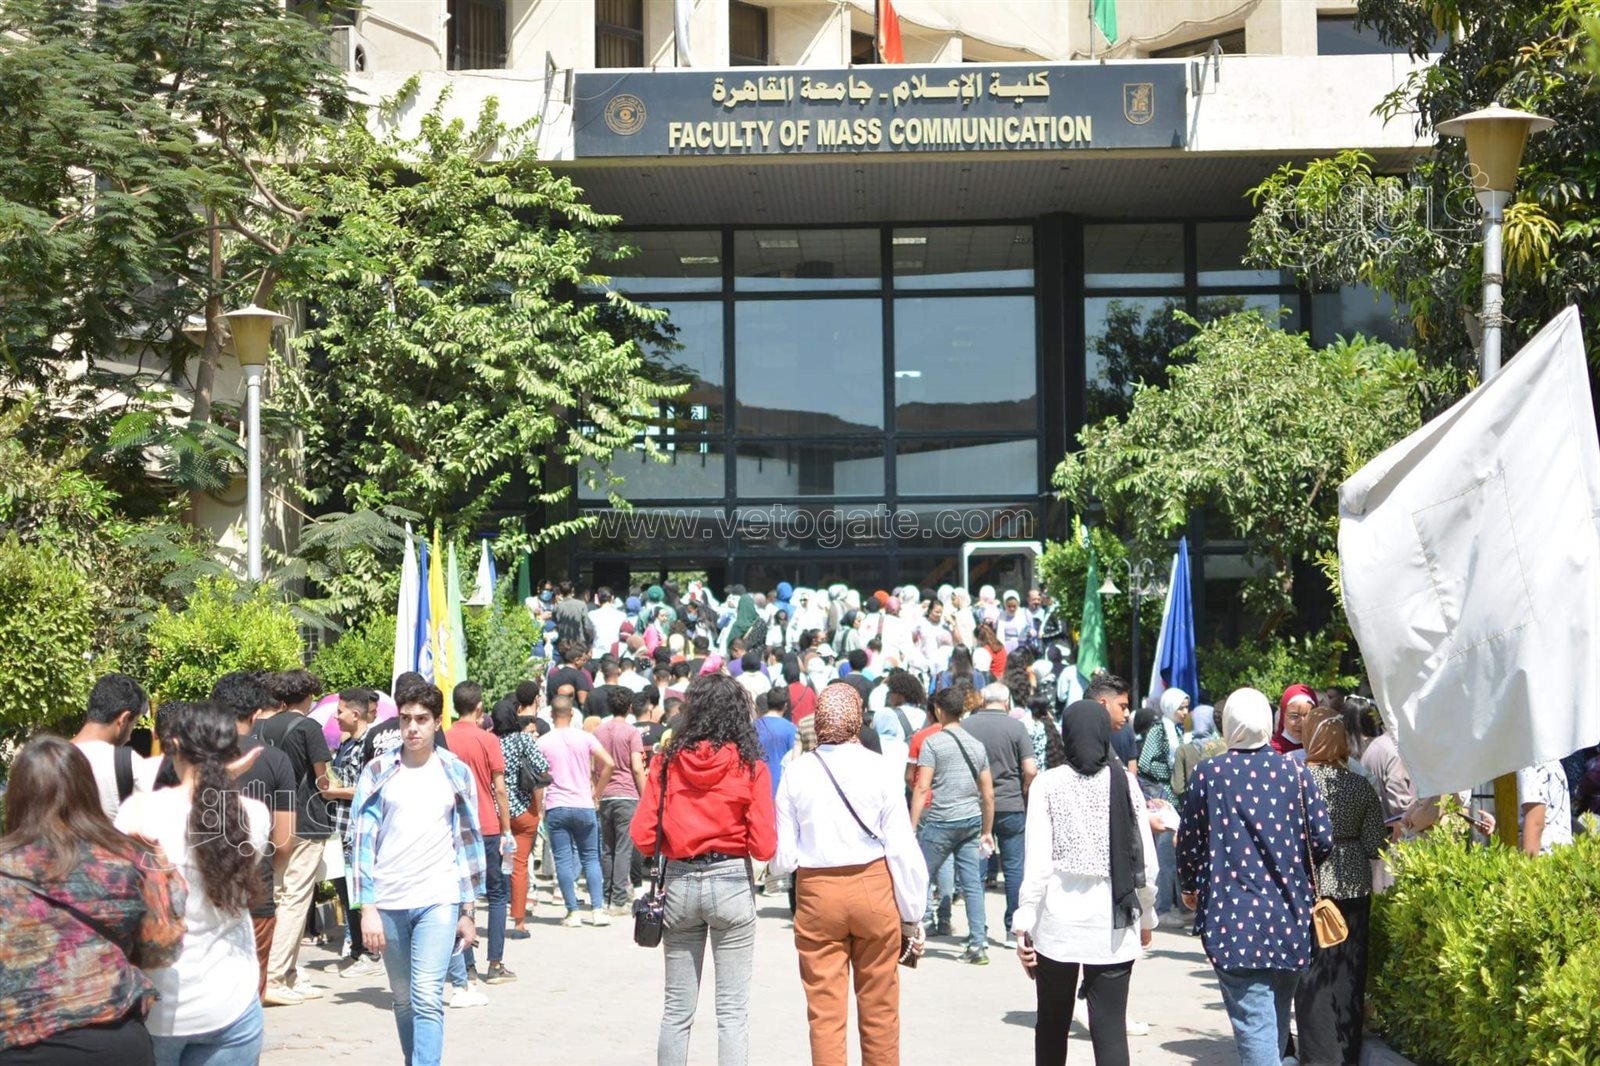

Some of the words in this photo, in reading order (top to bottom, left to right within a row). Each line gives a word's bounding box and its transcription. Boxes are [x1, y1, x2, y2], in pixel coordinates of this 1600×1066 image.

[712, 76, 795, 108] القاهرة
[800, 75, 874, 105] جامعة
[892, 72, 983, 108] الإعلام
[989, 71, 1050, 104] كلية
[668, 120, 774, 148] FACULTY
[779, 119, 811, 146] OF
[817, 117, 882, 145] MASS
[889, 115, 1093, 145] COMMUNICATION
